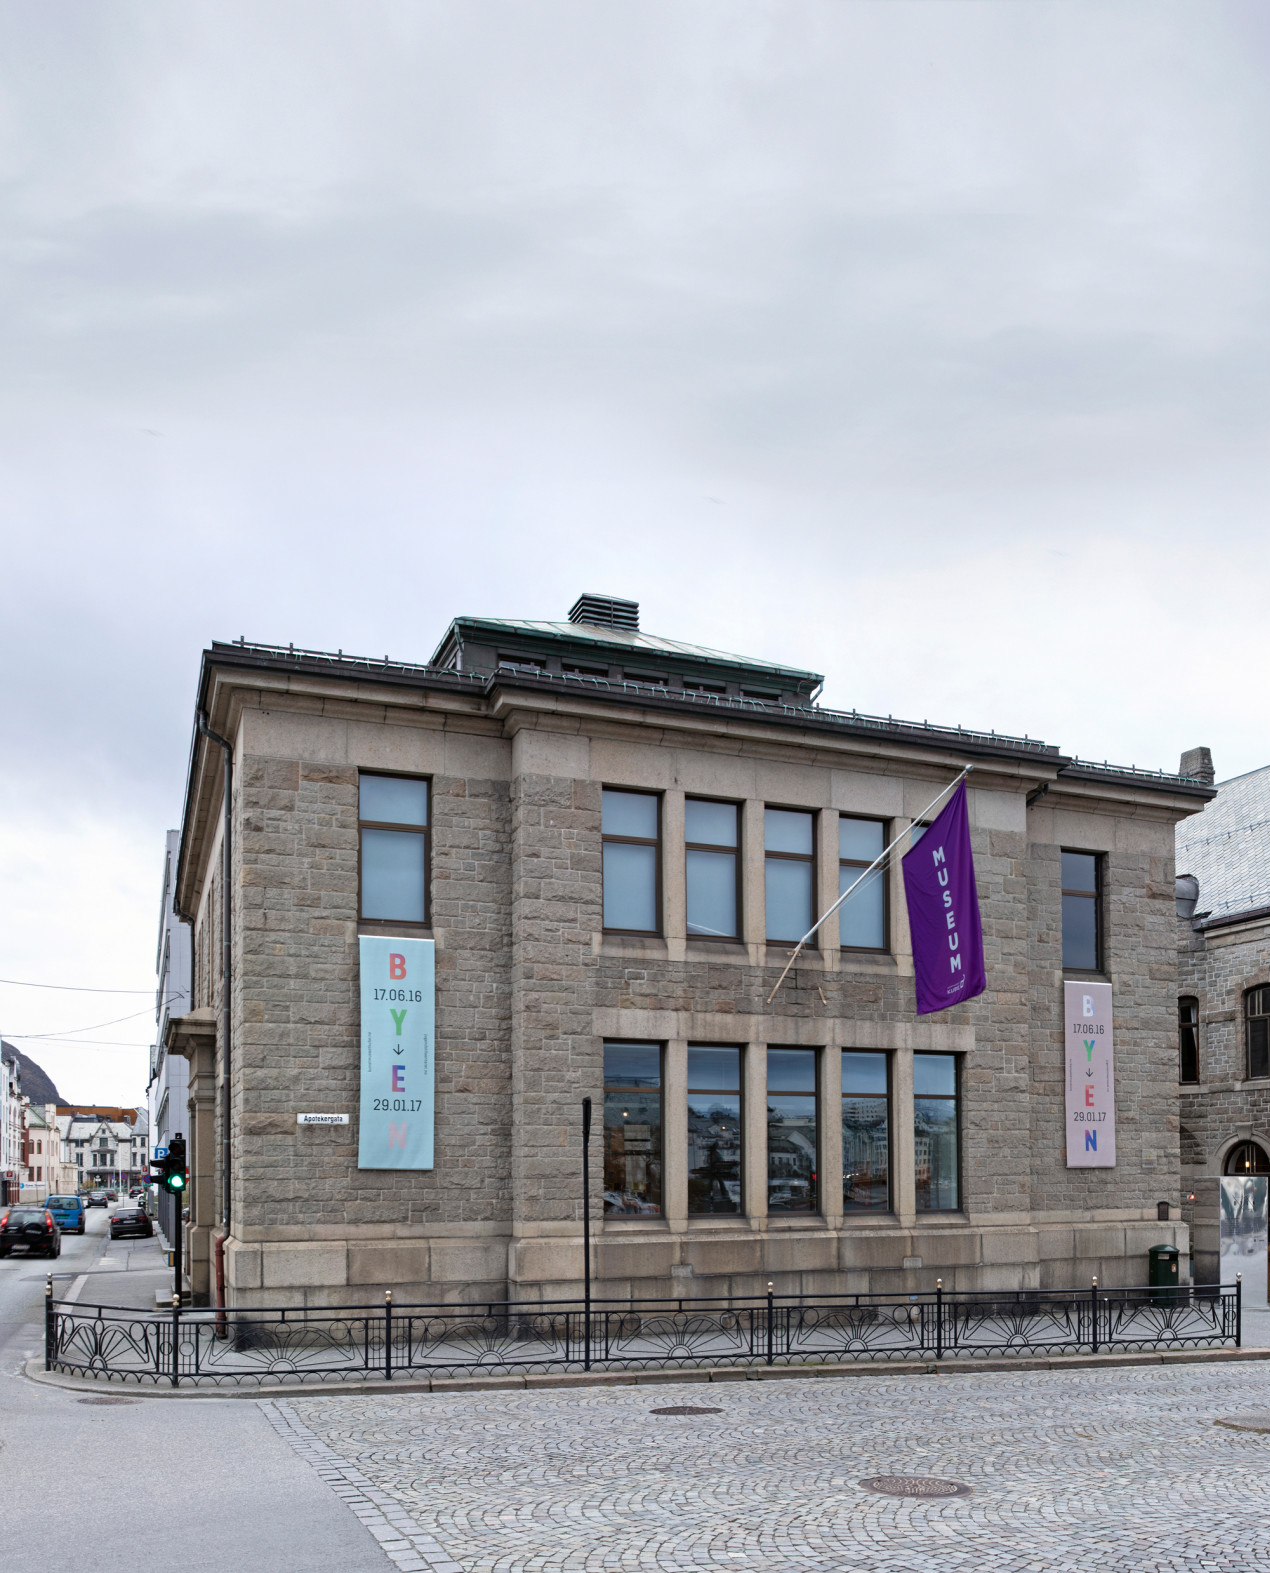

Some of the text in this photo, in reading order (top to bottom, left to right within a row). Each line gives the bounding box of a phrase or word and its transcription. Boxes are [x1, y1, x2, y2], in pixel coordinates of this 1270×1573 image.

[932, 846, 962, 974] MUSEUM
[373, 988, 422, 1003] 17.06.16
[1073, 1023, 1105, 1035] 17.06.16
[373, 1098, 422, 1112] 29.01.17
[303, 1115, 343, 1123] Apotekergata
[1073, 1111, 1107, 1122] 29.01.17
